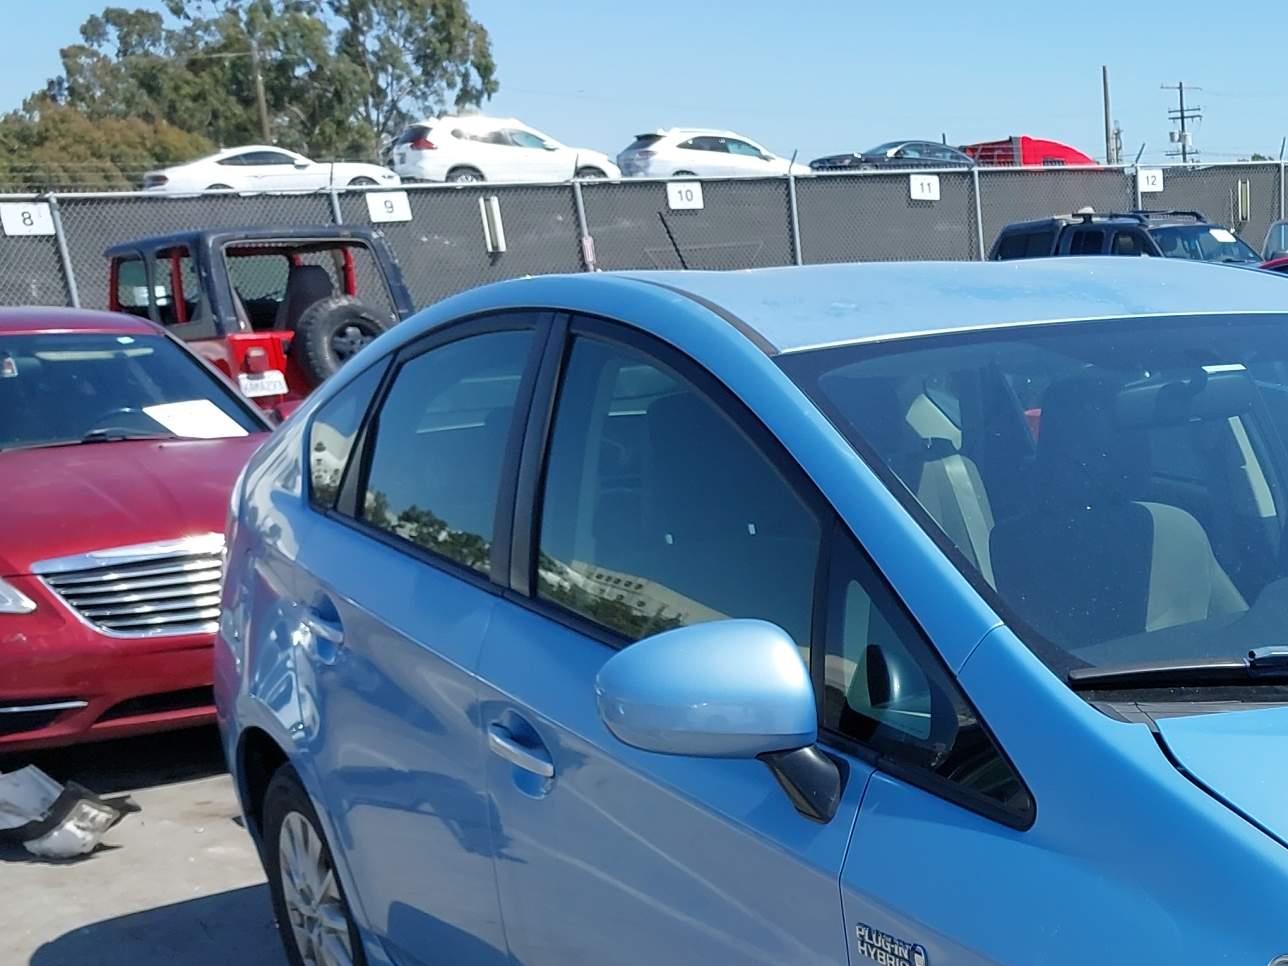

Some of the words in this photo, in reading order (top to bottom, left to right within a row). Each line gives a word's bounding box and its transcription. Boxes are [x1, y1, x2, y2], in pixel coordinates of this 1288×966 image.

[919, 181, 933, 194] 11
[1145, 175, 1158, 186] 12
[677, 188, 694, 203] 10
[384, 200, 395, 214] 9
[20, 211, 34, 227] 8
[855, 924, 910, 959] PLUG-IN
